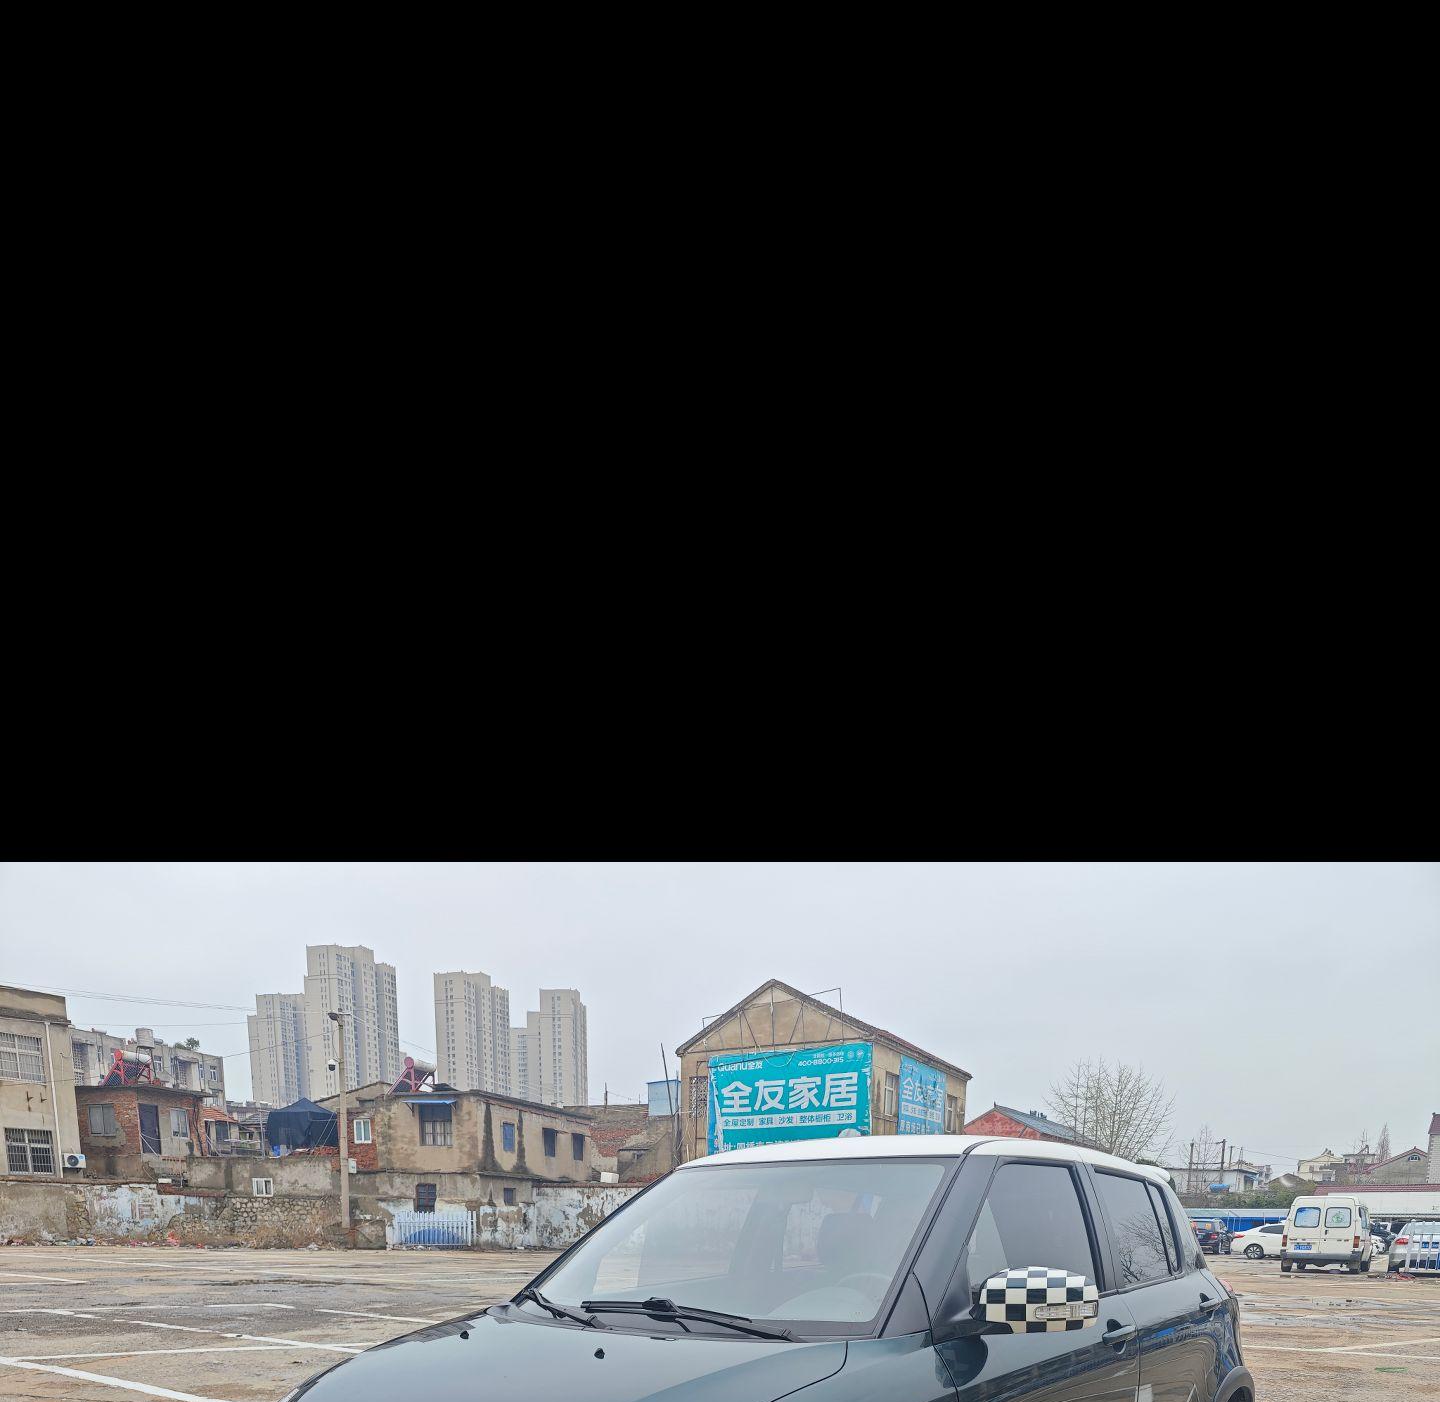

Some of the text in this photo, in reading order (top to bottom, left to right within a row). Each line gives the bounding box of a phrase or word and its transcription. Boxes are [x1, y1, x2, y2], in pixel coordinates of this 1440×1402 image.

[720, 1072, 859, 1114] 全友家居
[778, 1115, 794, 1125] 沙发
